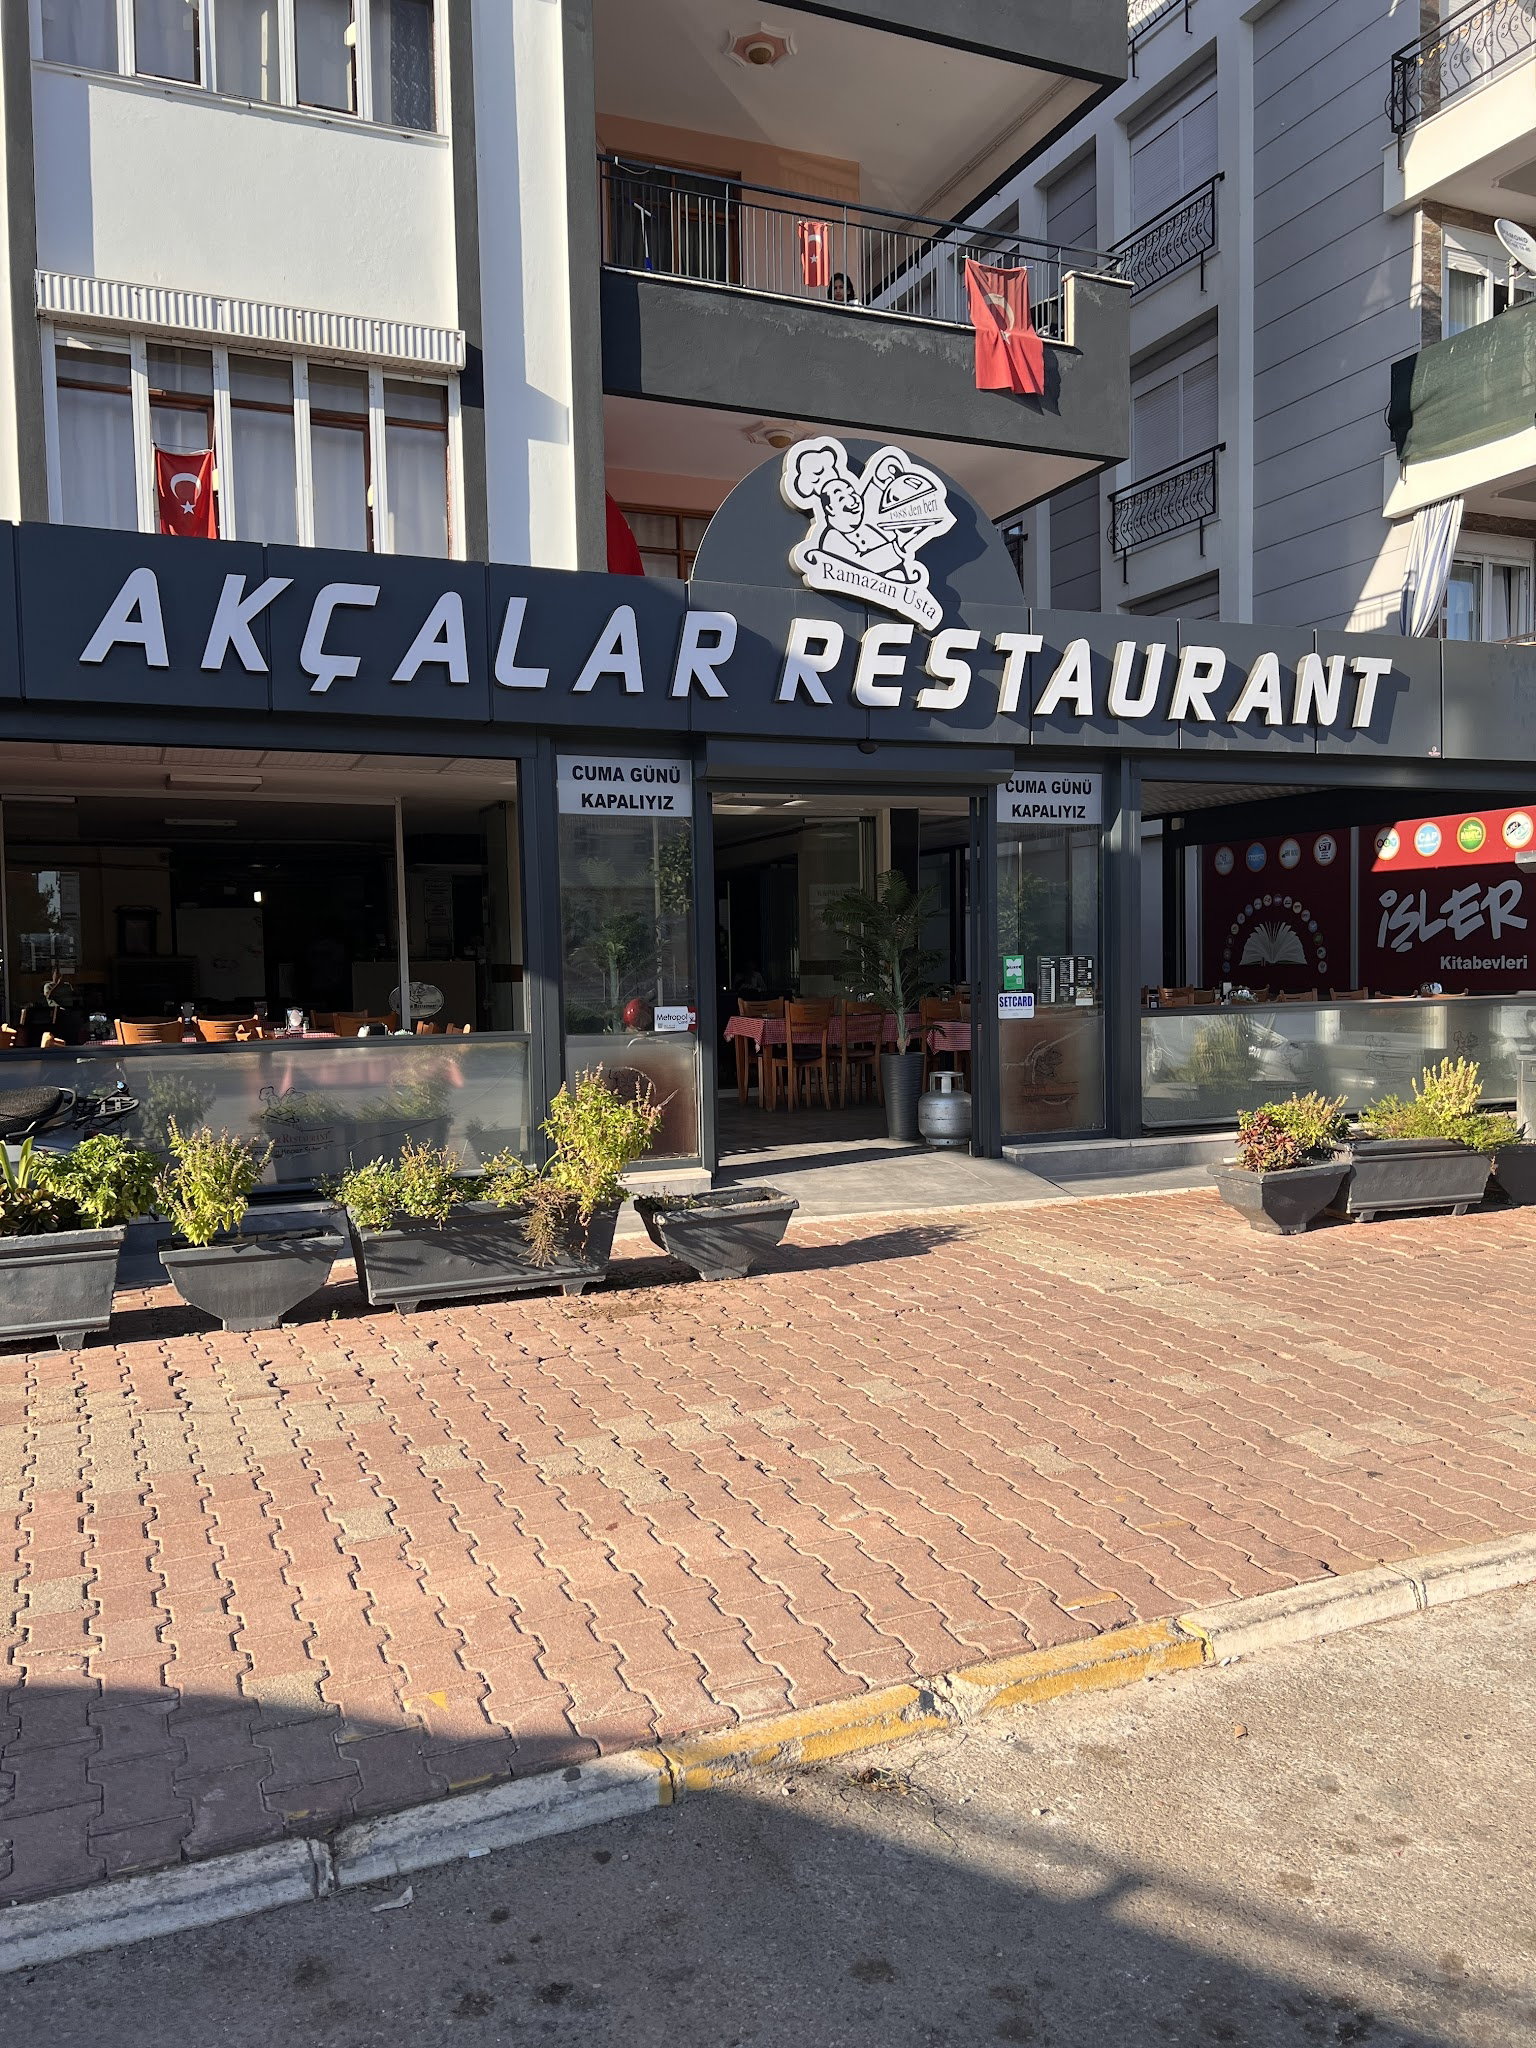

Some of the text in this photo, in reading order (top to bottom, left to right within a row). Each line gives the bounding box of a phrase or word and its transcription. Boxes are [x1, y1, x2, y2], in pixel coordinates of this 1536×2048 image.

[908, 504, 923, 517] den
[821, 562, 937, 620] Ramazan Usta
[78, 567, 1393, 729] AKÇALAR RESTAURANT
[571, 764, 681, 784] CUMA GÜNÜ
[1005, 778, 1092, 795] CUMA GÜNÜ
[581, 793, 675, 810] KAPALIYIZ
[1011, 804, 1086, 819] KAPALIYIZ
[1440, 954, 1528, 970] Kitabevleri
[999, 995, 1033, 1008] SETCARD
[656, 1013, 688, 1021] Metropol
